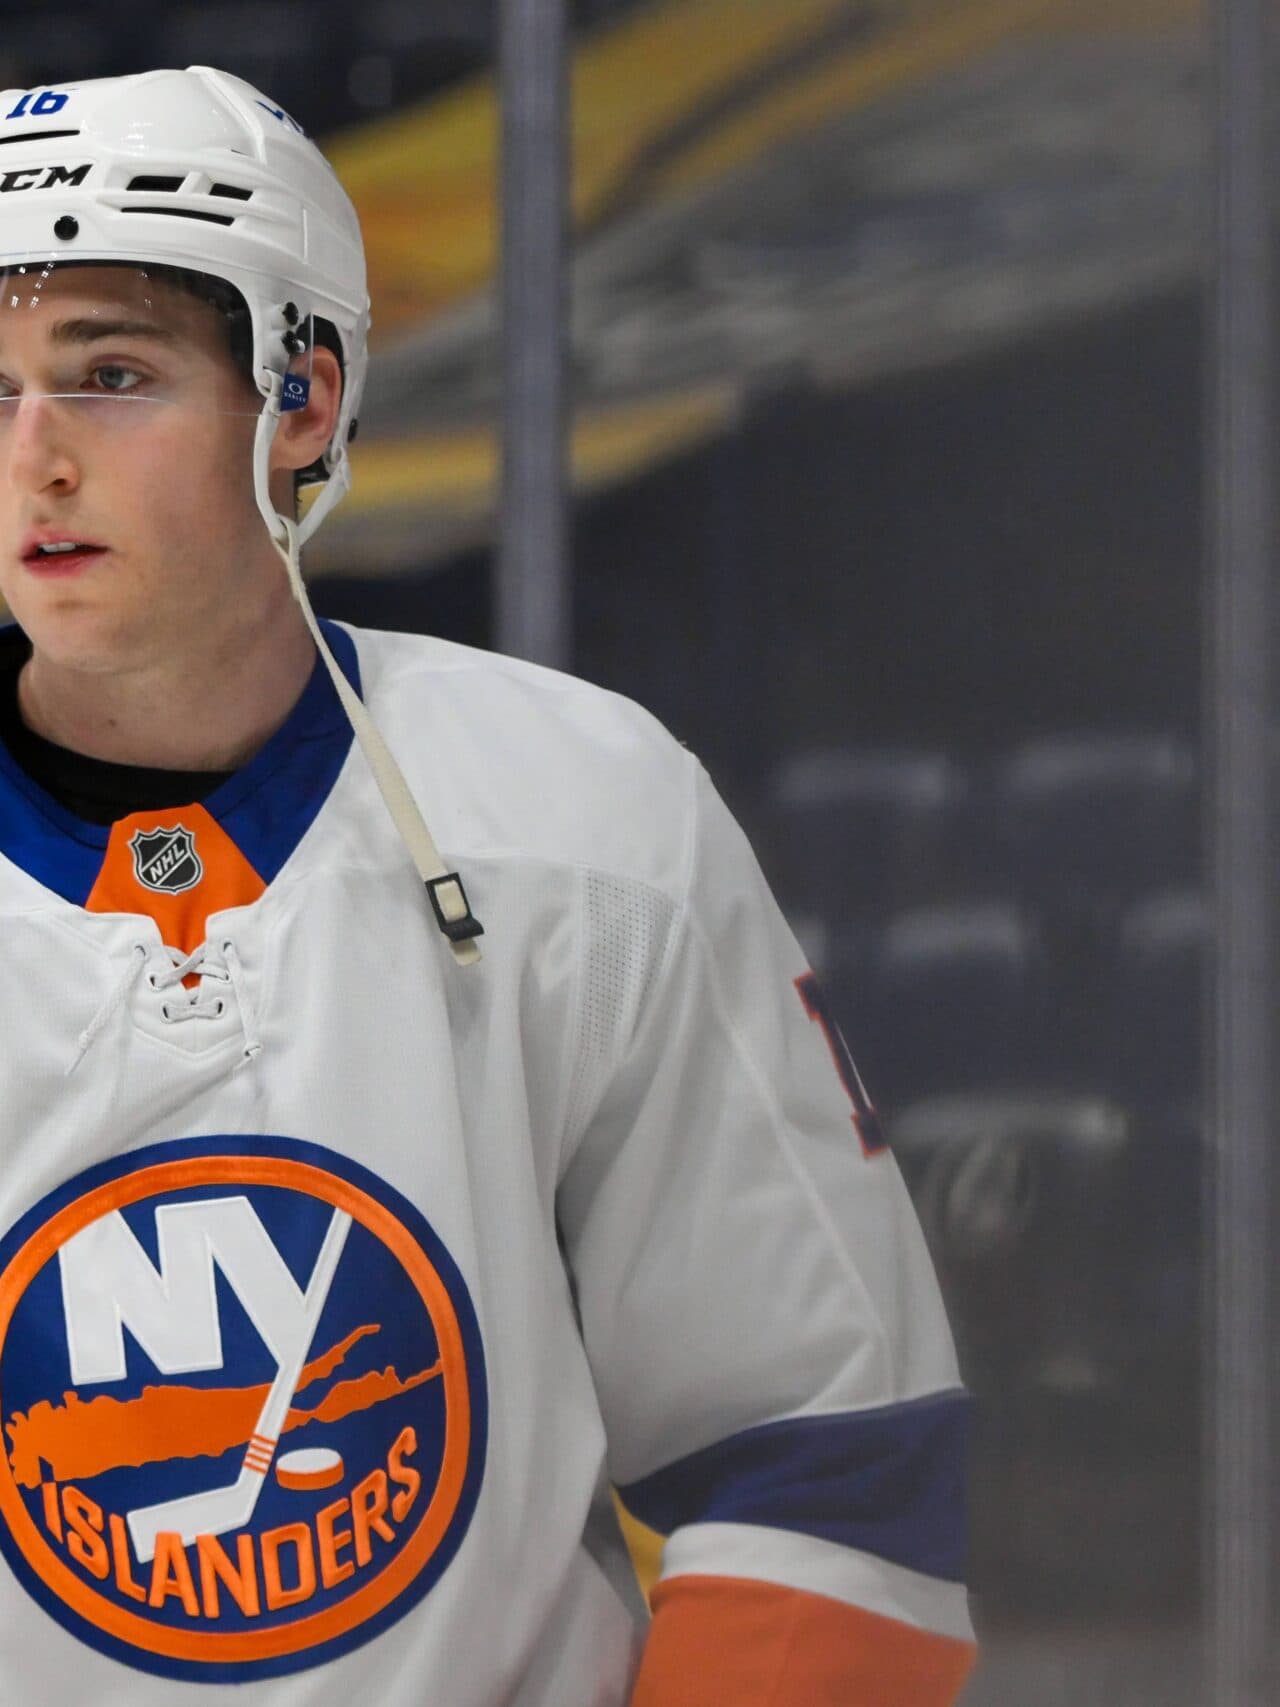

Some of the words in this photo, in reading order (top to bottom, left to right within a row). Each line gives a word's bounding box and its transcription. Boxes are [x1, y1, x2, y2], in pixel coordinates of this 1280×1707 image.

[5, 91, 69, 120] 16
[150, 843, 185, 882] NHL
[58, 1195, 354, 1475] NY
[42, 1426, 420, 1618] ISLANDERS
